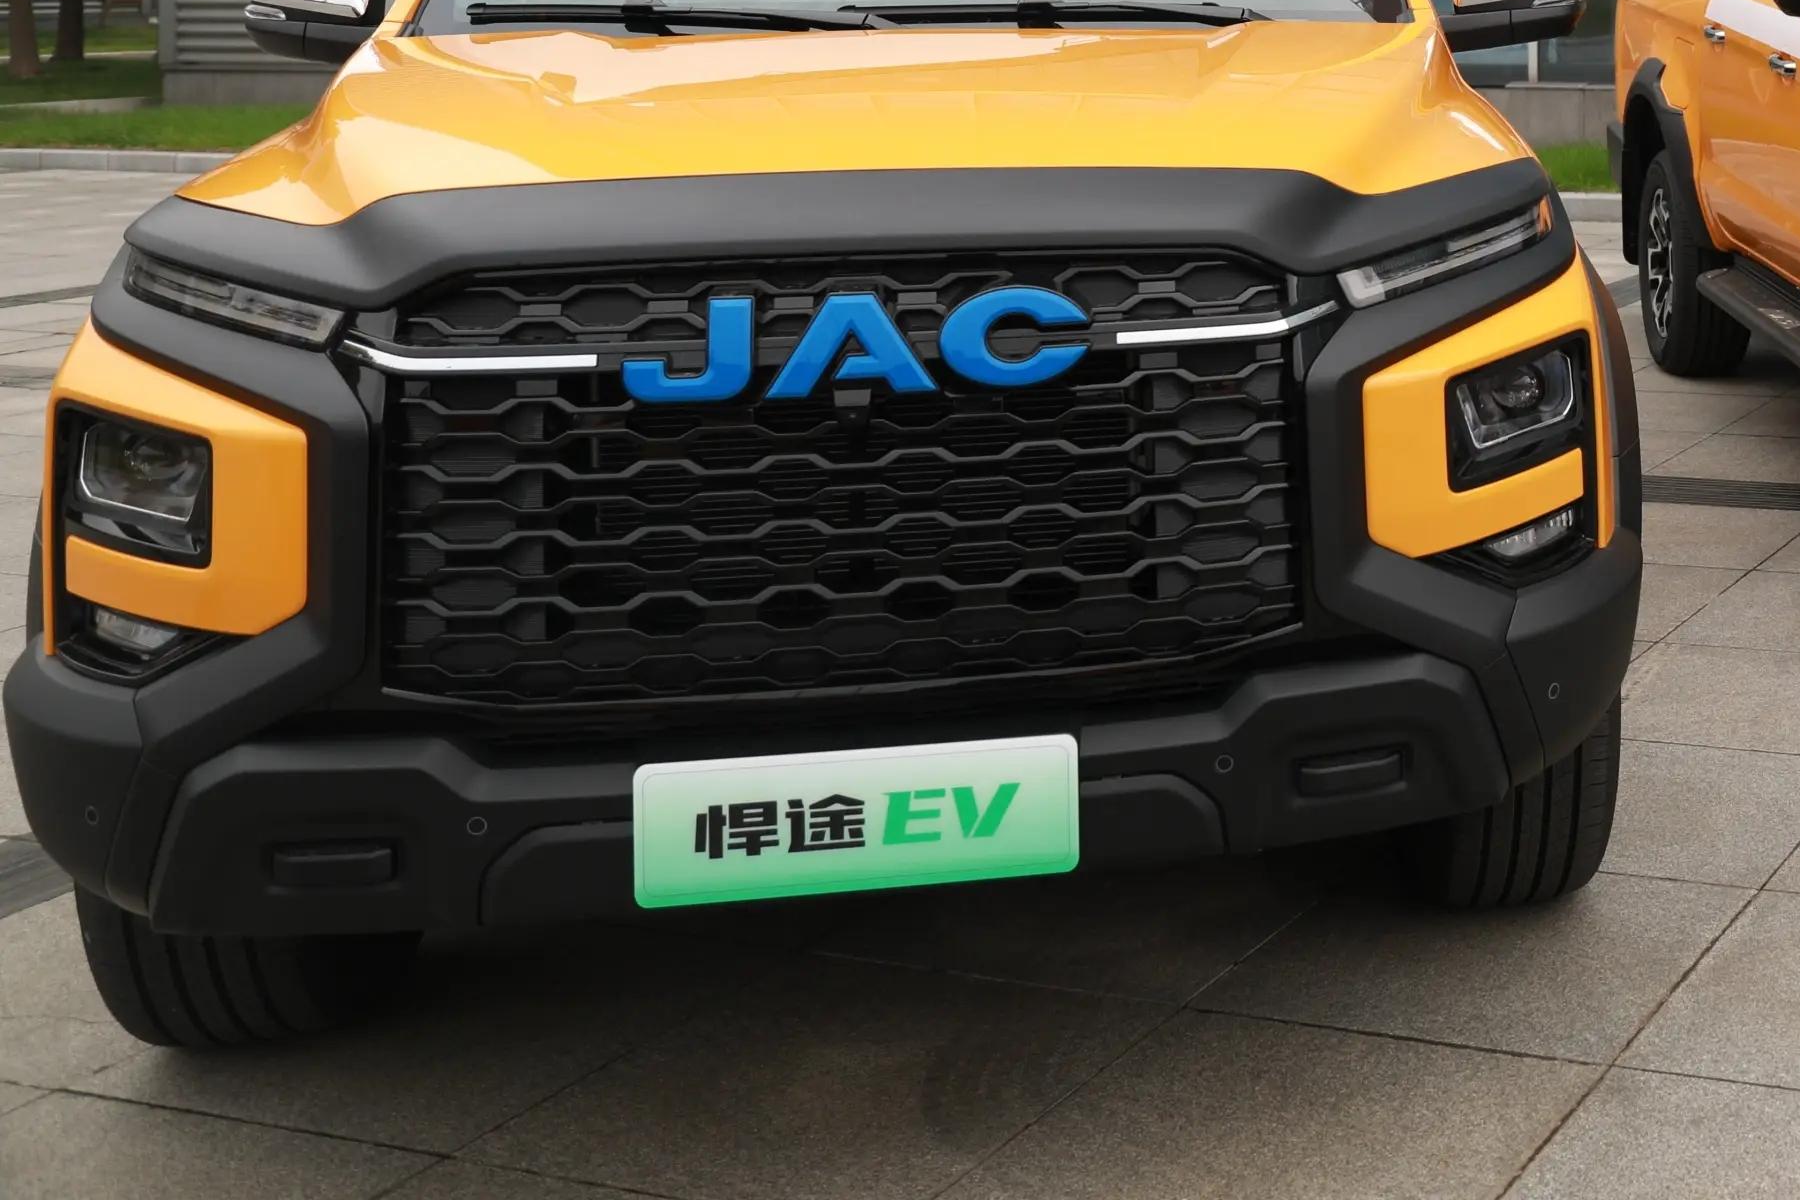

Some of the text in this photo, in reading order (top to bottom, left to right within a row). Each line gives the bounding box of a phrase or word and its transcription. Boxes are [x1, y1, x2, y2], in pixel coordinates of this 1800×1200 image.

[621, 285, 1090, 403] JAC
[694, 782, 1021, 859] 悍途 EV
